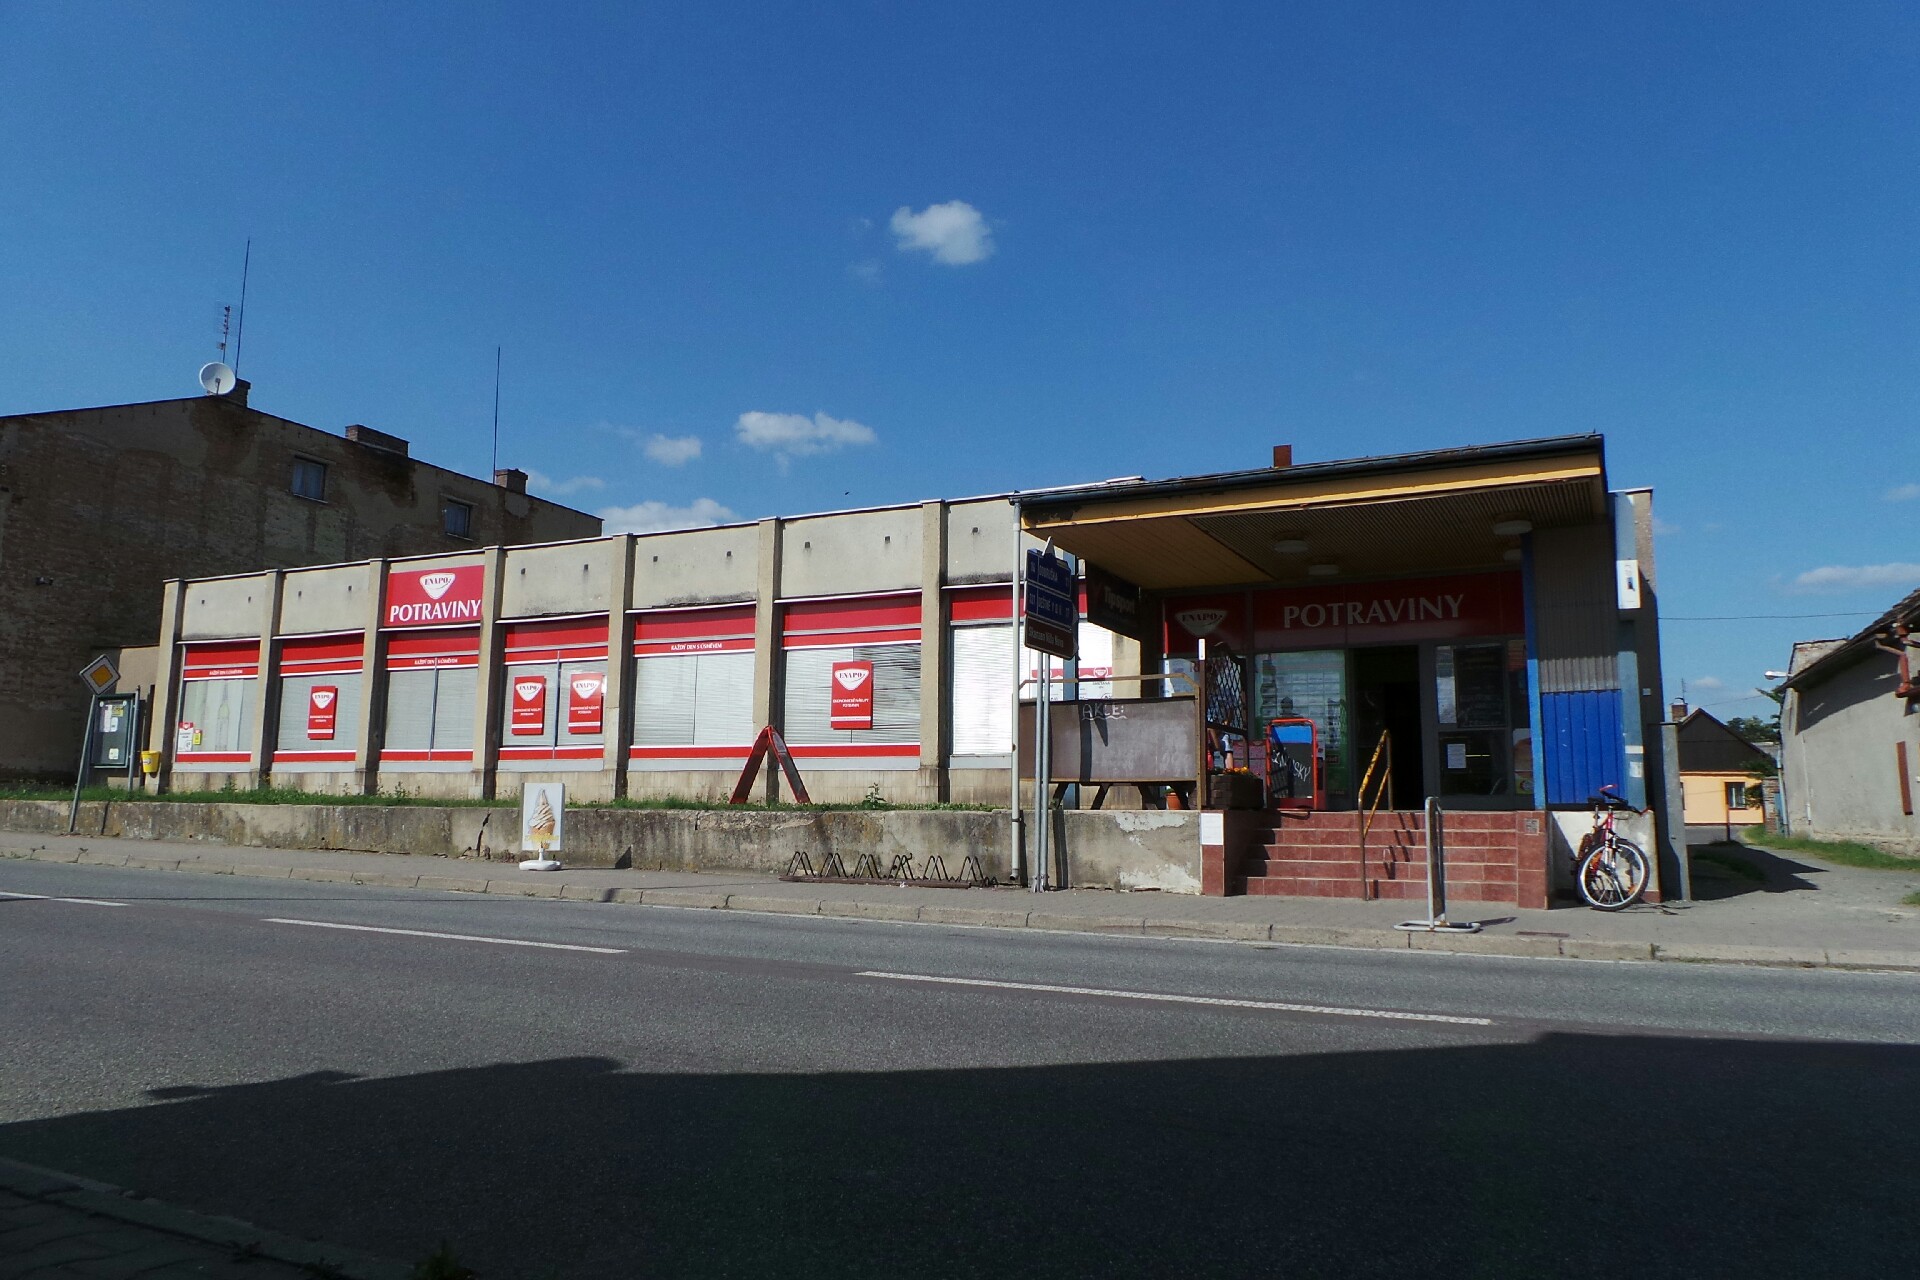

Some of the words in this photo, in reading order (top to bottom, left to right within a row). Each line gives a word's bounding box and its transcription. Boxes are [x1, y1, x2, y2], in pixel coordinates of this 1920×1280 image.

[424, 577, 449, 586] ENAPO
[390, 599, 481, 622] POTRAVINY
[1103, 585, 1136, 615] Tipsport
[1283, 594, 1464, 628] POTRAVINY
[1181, 612, 1219, 622] ENAPO
